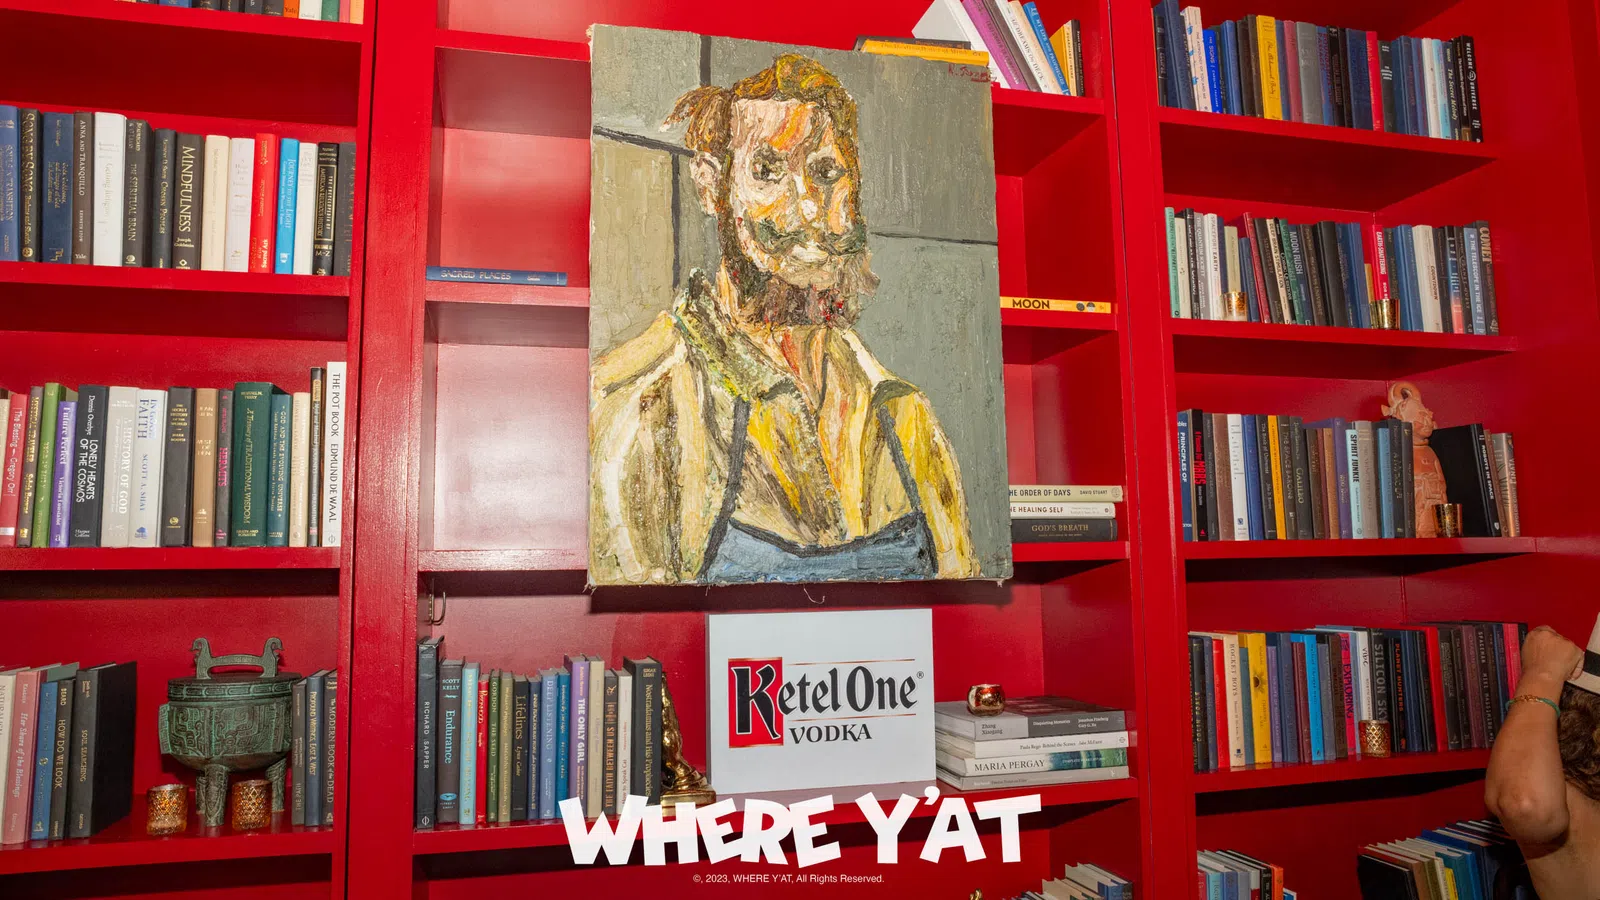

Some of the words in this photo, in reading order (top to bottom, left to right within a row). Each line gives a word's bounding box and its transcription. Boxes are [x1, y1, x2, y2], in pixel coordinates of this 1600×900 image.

[1015, 27, 1031, 54] DREAMS
[1032, 63, 1045, 81] DECK
[1469, 82, 1477, 110] UNIVERSE
[22, 161, 35, 192] SONG
[78, 153, 86, 196] TRANQUILLO
[287, 159, 296, 186] JOURNEY
[128, 177, 138, 215] SPIRITUAL
[179, 146, 196, 232] MINDFULNESS
[128, 217, 136, 241] BRAIN
[285, 209, 294, 228] LIGHT
[317, 217, 325, 236] HISTORY
[1196, 228, 1204, 256] QUANTUM
[1289, 231, 1299, 253] MOON
[1376, 231, 1386, 275] EARTH-SHATTERING
[1479, 227, 1492, 264] COMET
[441, 270, 476, 279] SACRED
[479, 271, 511, 280] PLACES
[1275, 255, 1284, 289] STIMULATION
[1293, 254, 1304, 275] RUSH
[1471, 252, 1479, 283] TELESCOPE
[1430, 265, 1439, 300] COUNTDOWN
[1012, 299, 1050, 309] MOON
[332, 373, 340, 389] THE
[331, 391, 340, 409] POT
[14, 411, 23, 422] The
[62, 407, 71, 435] Future
[138, 399, 149, 439] FAITH
[331, 411, 340, 437] BOOK
[10, 423, 21, 448] Blessing
[80, 438, 90, 450] OF
[1350, 434, 1358, 457] SPIRIT
[59, 436, 69, 465] Perfect
[79, 452, 88, 466] THE
[88, 440, 99, 468] LONELY
[121, 427, 132, 472] HISTORY
[1284, 446, 1292, 468] SPACE
[1481, 444, 1489, 470] ROBOTS
[6, 457, 17, 481] Gregory
[218, 447, 228, 487] HERMITS
[244, 444, 254, 491] TRADITIONAL
[277, 453, 285, 482] EVOLVING
[330, 443, 339, 482] EDMUND
[1194, 460, 1207, 485] MARS
[1351, 458, 1360, 483] JUNKIE
[75, 468, 86, 503] COSMOS
[86, 471, 97, 500] HEARTS
[120, 474, 129, 488] OF
[329, 484, 338, 495] DE
[1182, 472, 1187, 483] OF
[1296, 467, 1305, 504] GALILEO
[118, 491, 128, 514] GOD
[139, 492, 147, 511] SHAY
[243, 492, 253, 524] WISDOM
[328, 496, 338, 522] WAAL
[1031, 524, 1056, 532] GOD'S
[1374, 643, 1385, 694] SILICON
[1343, 663, 1354, 719] EXPLORING
[578, 698, 586, 714] THE
[645, 684, 653, 732] Nostradamus
[730, 664, 842, 744] Ketel
[846, 665, 918, 712] One
[1377, 699, 1387, 721] SKY
[20, 712, 29, 725] Her
[58, 719, 66, 739] HOW
[328, 706, 336, 743] MODERN
[515, 695, 527, 740] Lifelines
[577, 716, 585, 740] ONLY
[18, 728, 28, 747] Share
[445, 710, 456, 764] Endurance
[606, 726, 615, 737] US
[645, 732, 653, 743] and
[789, 723, 873, 745] VODKA
[57, 741, 65, 753] DO
[327, 744, 335, 767] BOOK
[577, 742, 585, 763] GIRL
[605, 738, 614, 771] BETWEEN
[645, 743, 653, 753] His
[17, 756, 26, 767] the
[55, 754, 65, 766] WE
[79, 747, 87, 782] SEARCHING
[975, 762, 1007, 772] MARIA
[1009, 759, 1046, 770] PERGAY
[54, 767, 64, 789] LOOK
[605, 773, 614, 792] FAITH
[644, 754, 653, 796] Prophecies
[326, 780, 334, 803] DEAD
[605, 794, 614, 808] THE
